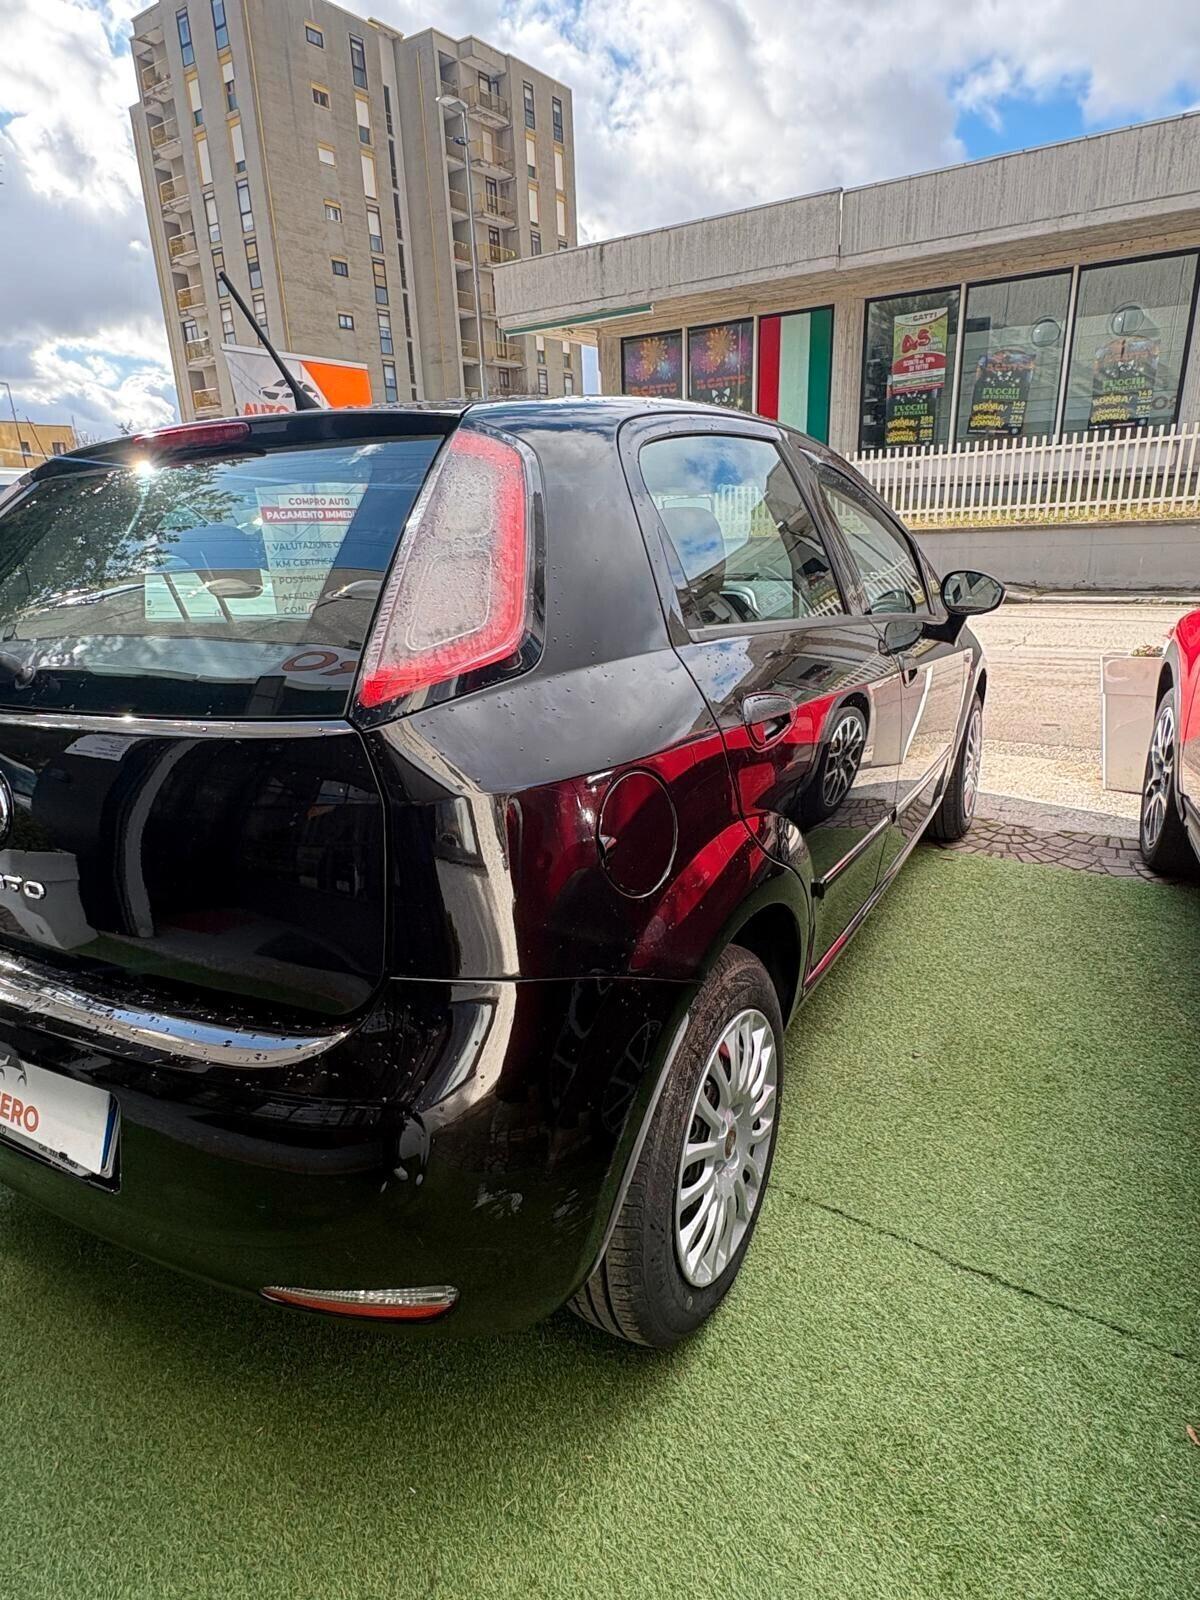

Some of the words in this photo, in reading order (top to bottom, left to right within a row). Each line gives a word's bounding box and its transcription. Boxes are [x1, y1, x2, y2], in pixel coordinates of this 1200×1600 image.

[708, 375, 747, 389] GATTO
[1103, 377, 1146, 388] FUOCHI
[894, 403, 928, 412] FUOCHI
[288, 497, 327, 506] COMPRO
[328, 498, 350, 506] AUTO
[266, 510, 324, 520] PAGAMENTO
[272, 541, 334, 552] VALUTAZIONE
[276, 560, 291, 568] KM
[284, 606, 304, 614] CON
[0, 1091, 39, 1132] ERO
